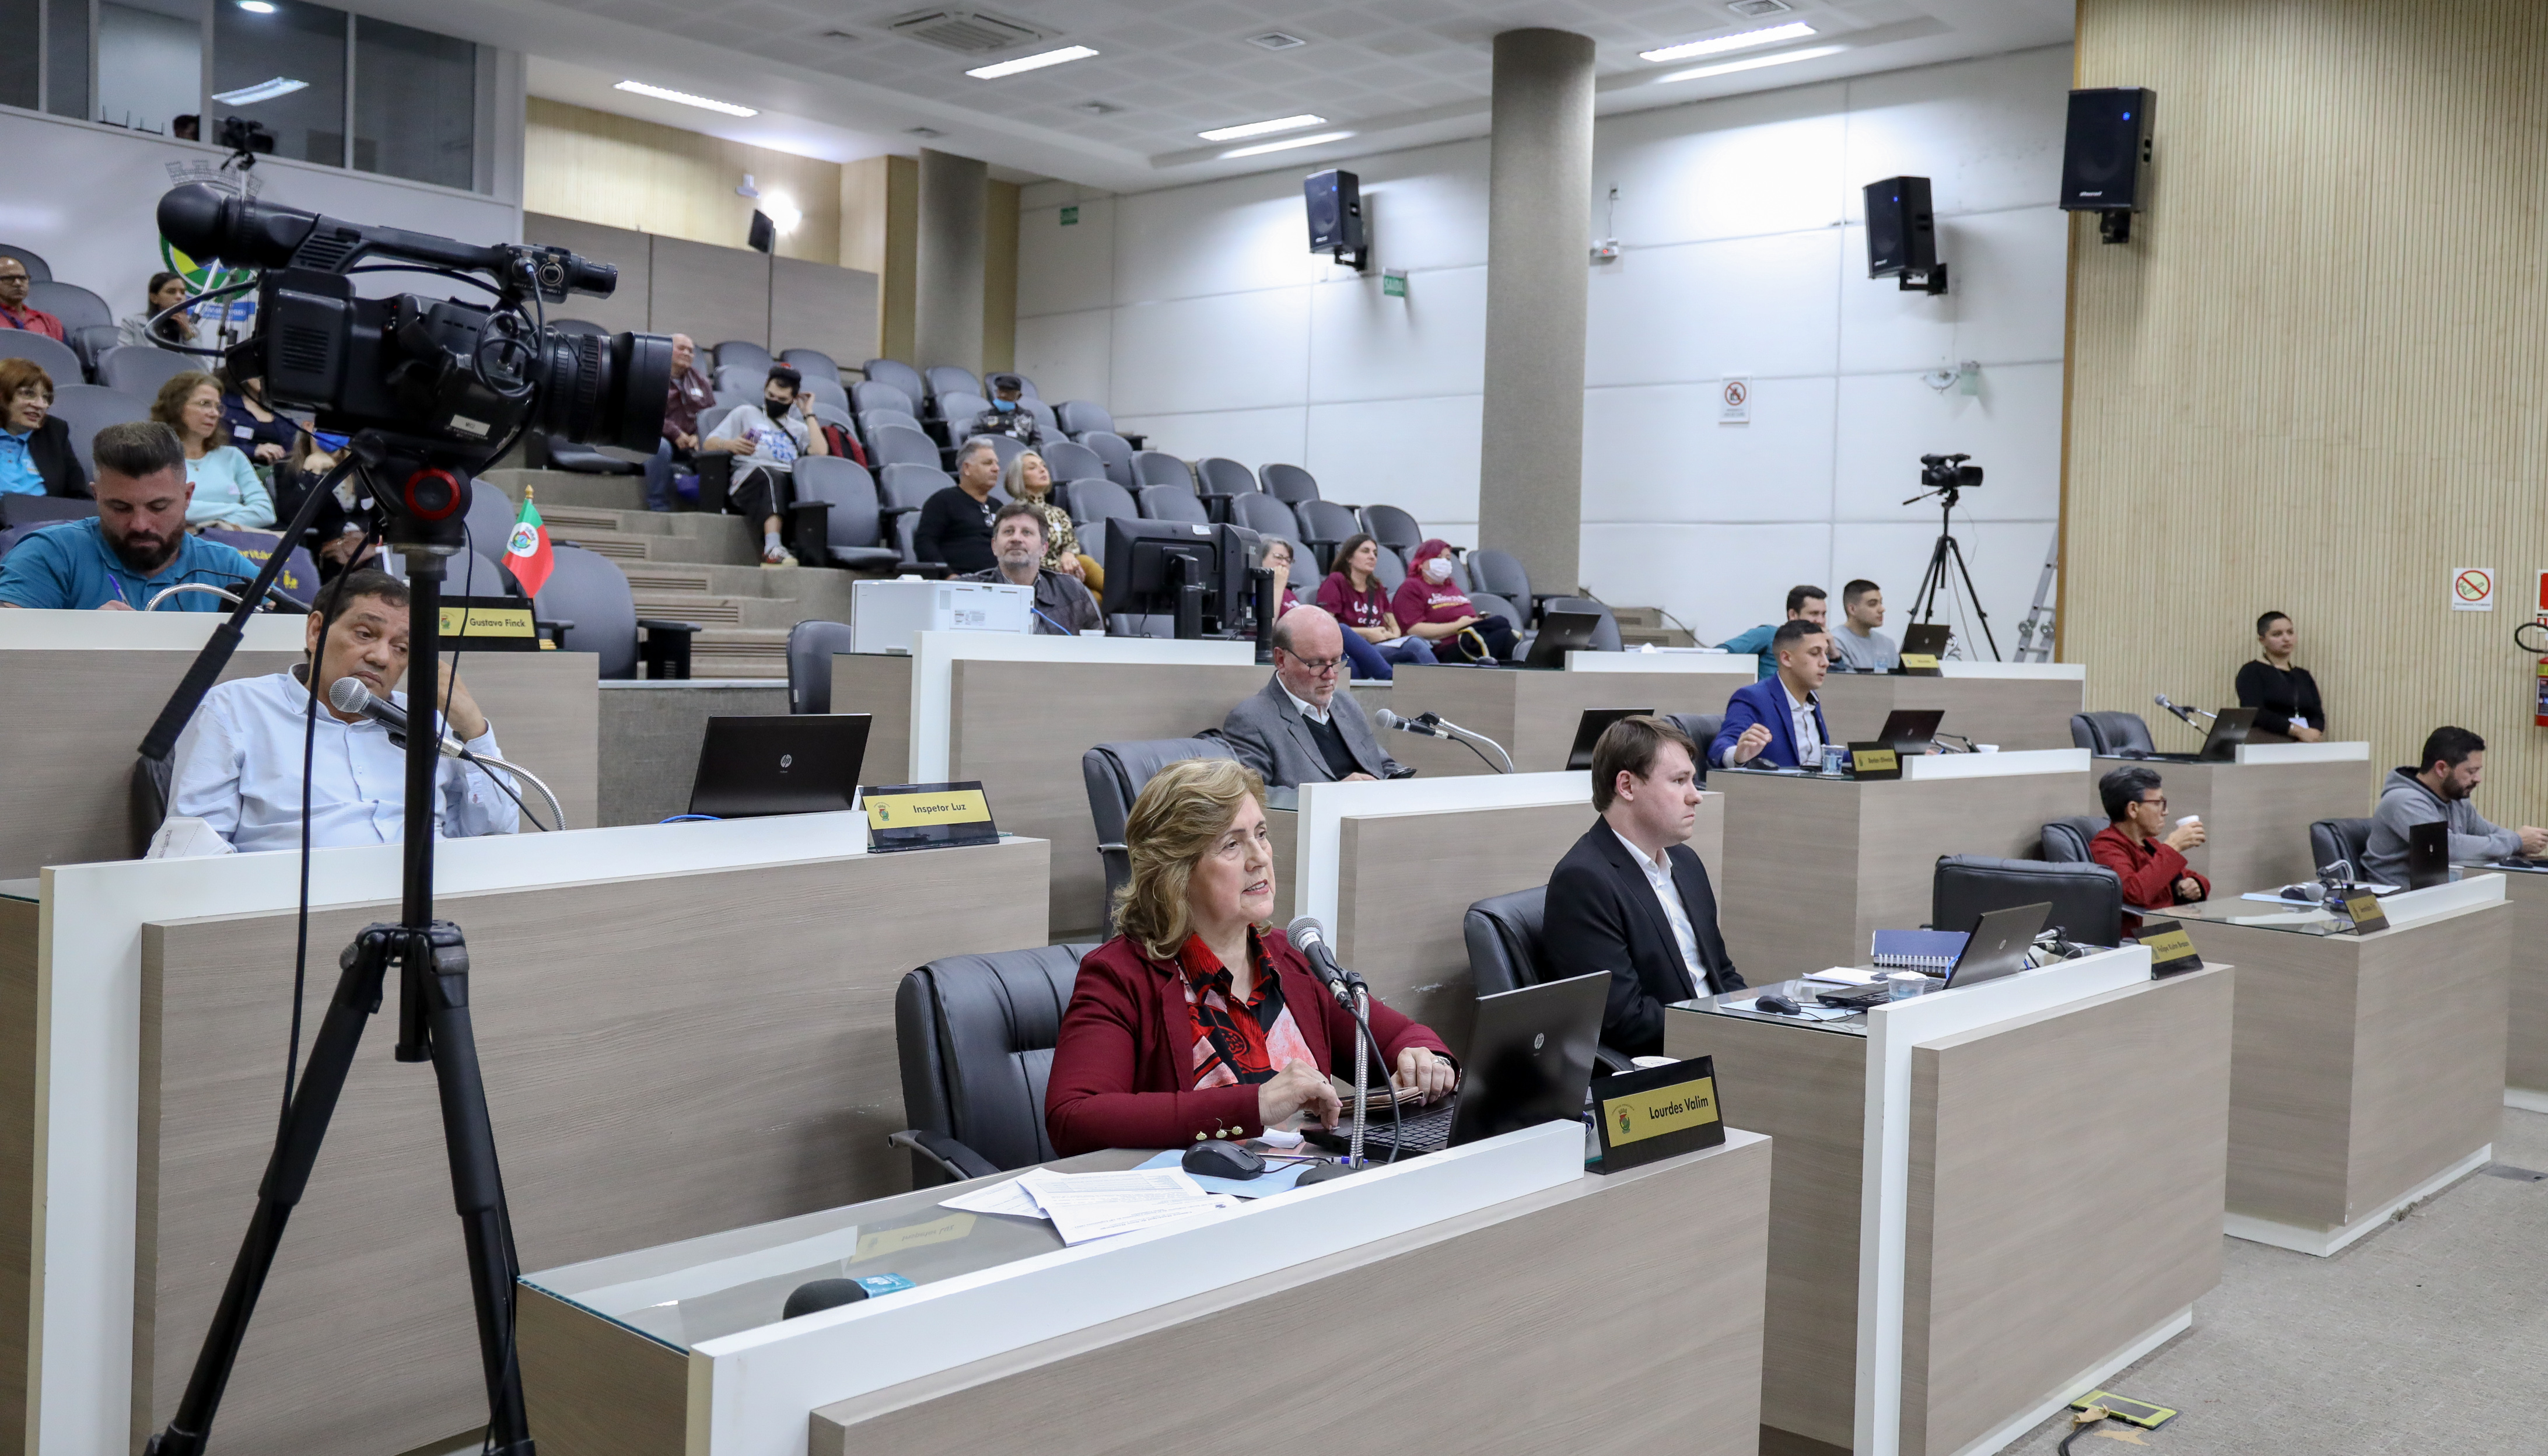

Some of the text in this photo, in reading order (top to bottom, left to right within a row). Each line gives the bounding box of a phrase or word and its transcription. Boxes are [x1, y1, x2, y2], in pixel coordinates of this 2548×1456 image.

[469, 618, 526, 628] Gustavo Finck
[913, 803, 967, 814] Inspetor Luz
[1648, 1101, 1684, 1120] Lourdes
[1684, 1095, 1709, 1111] Valim
